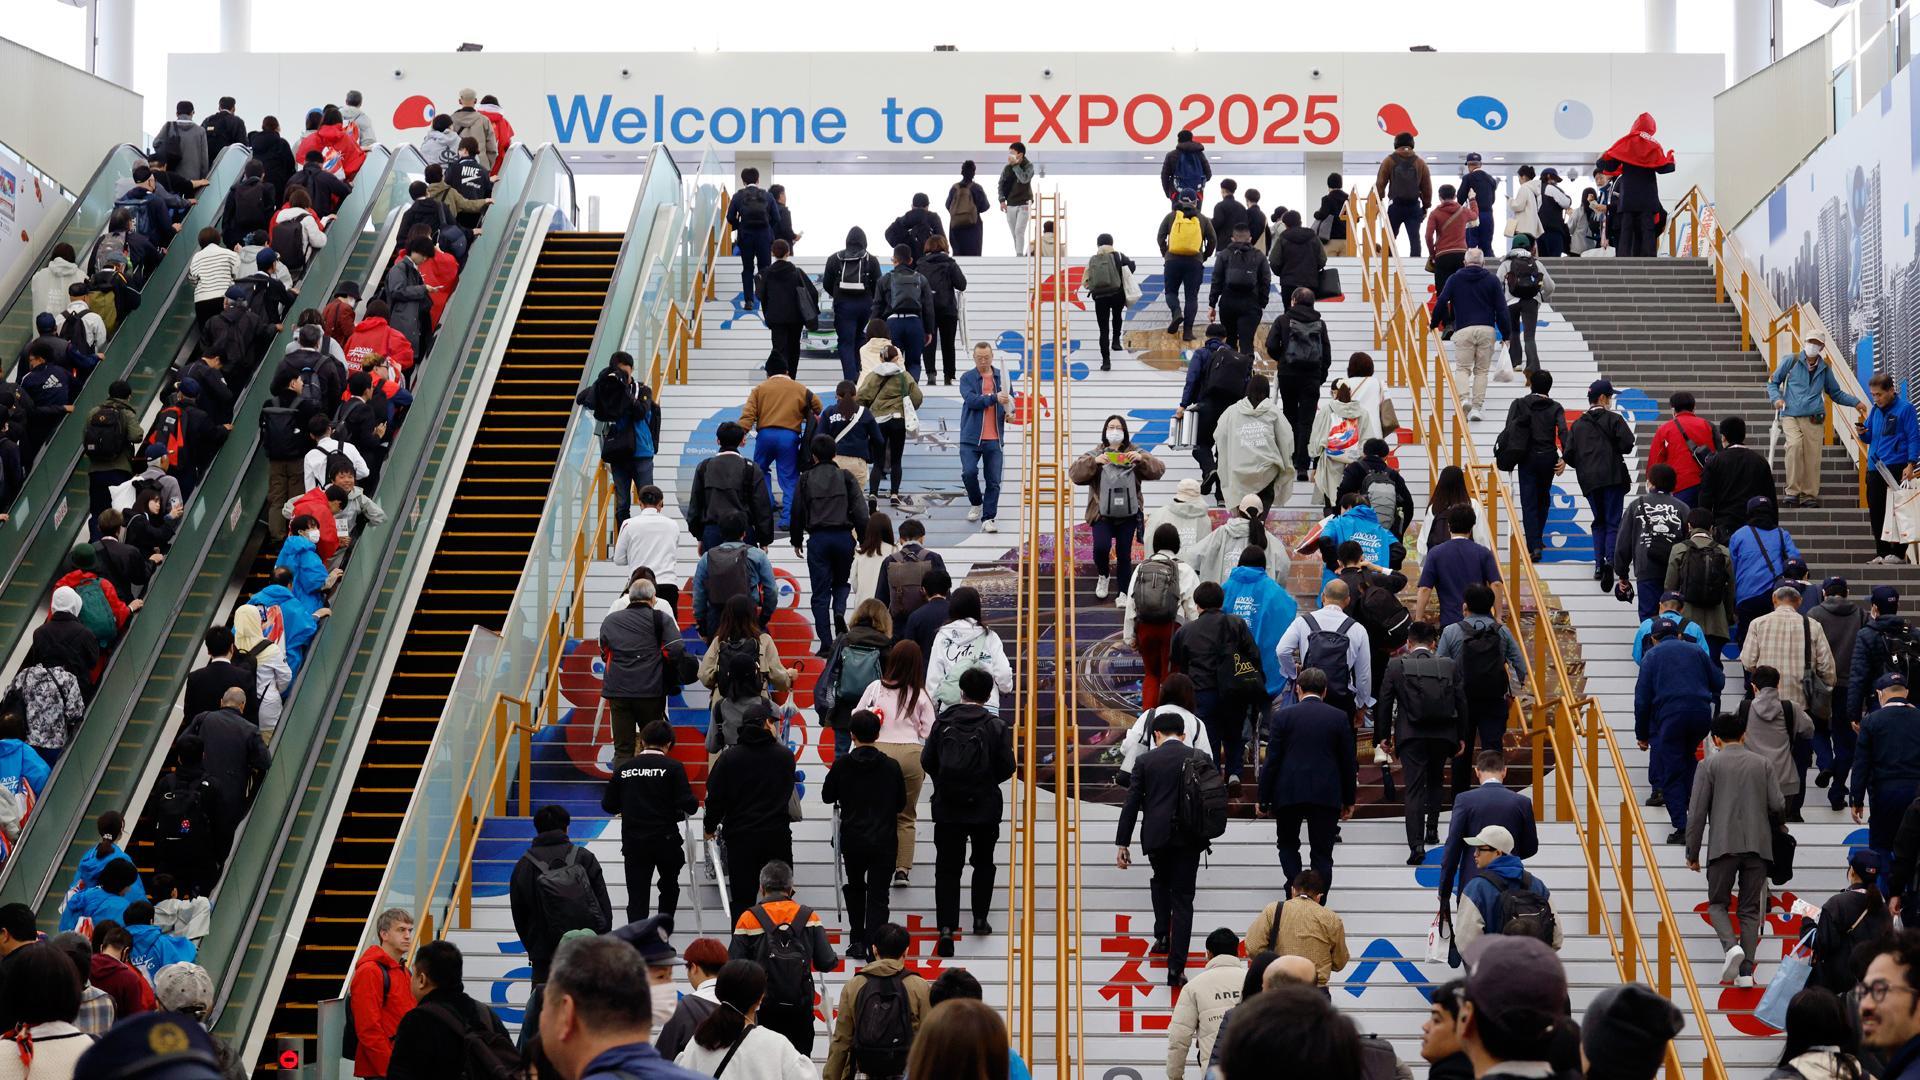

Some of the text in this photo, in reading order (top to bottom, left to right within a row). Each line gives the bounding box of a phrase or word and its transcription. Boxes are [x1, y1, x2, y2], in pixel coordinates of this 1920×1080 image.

[547, 93, 1342, 145] Welcome to EXPO2025
[461, 165, 480, 177] NIKE
[620, 768, 667, 779] SECURITY
